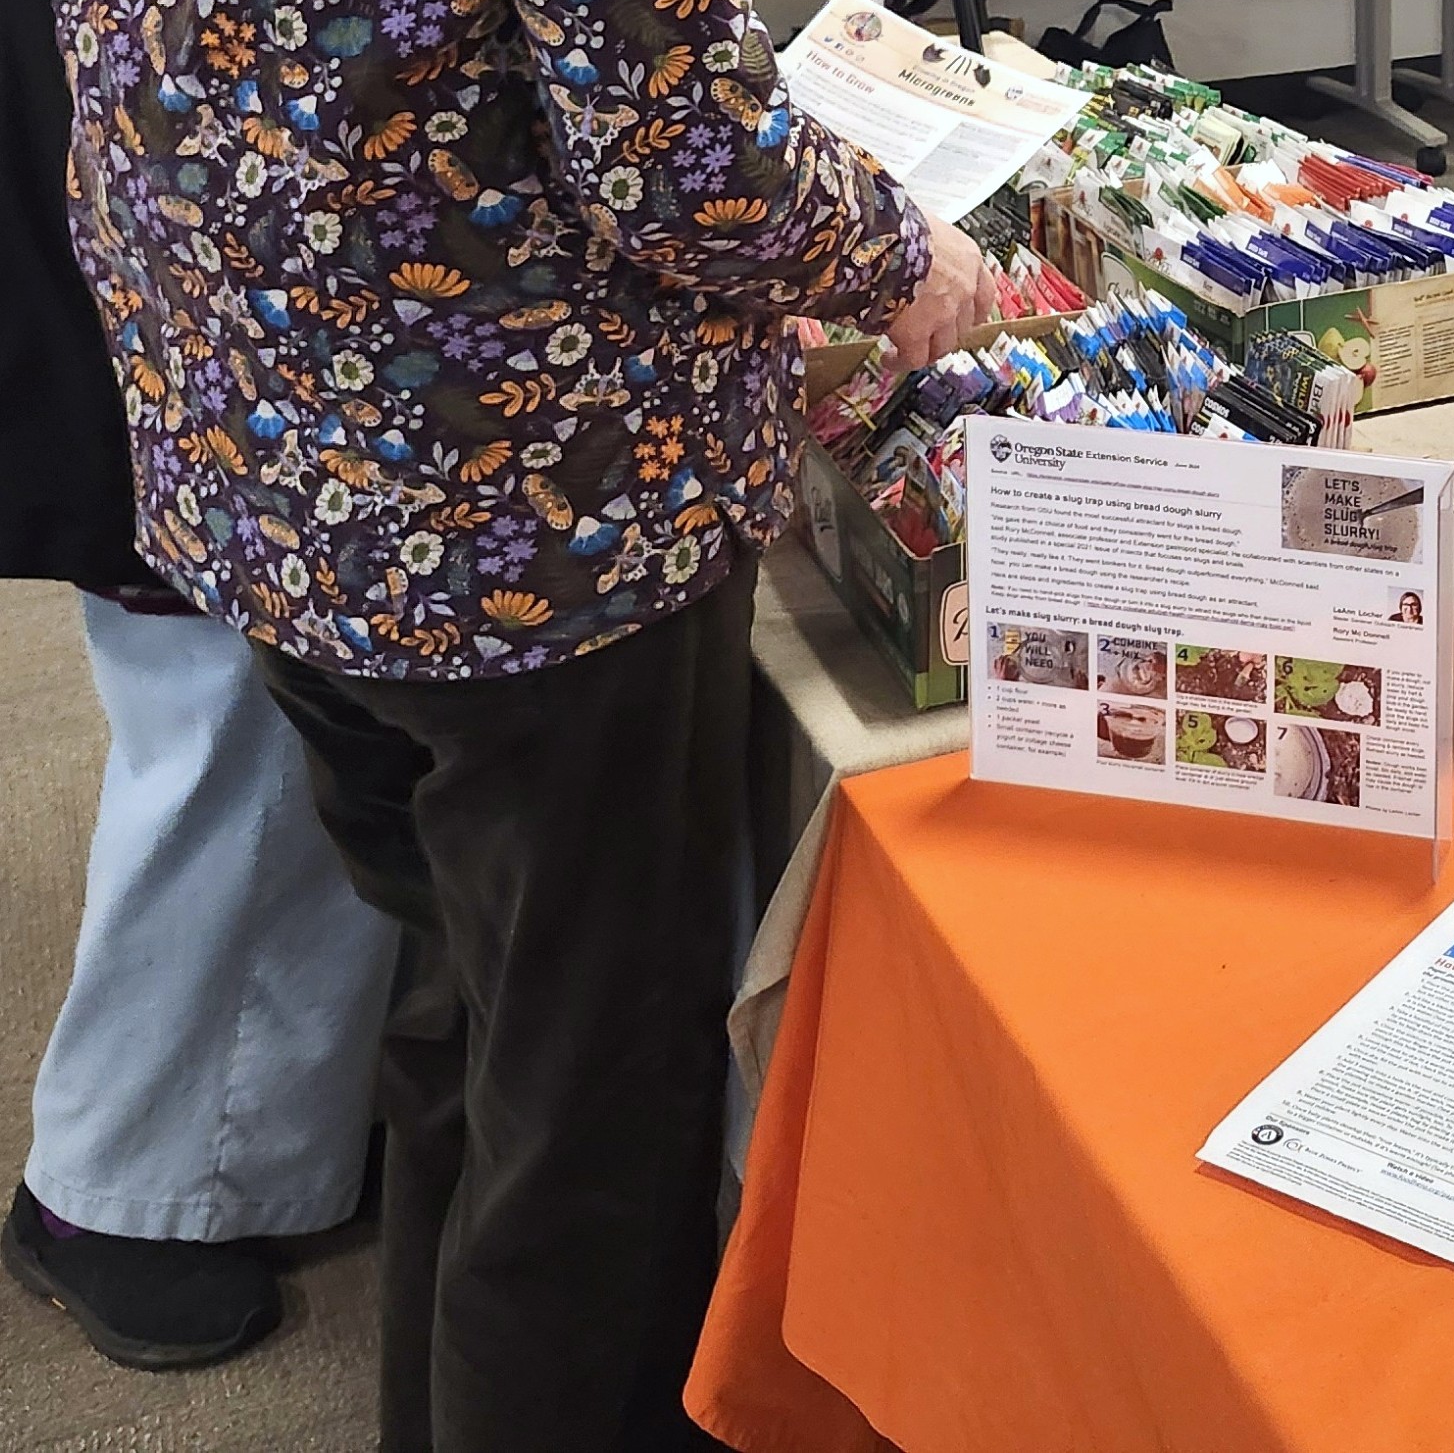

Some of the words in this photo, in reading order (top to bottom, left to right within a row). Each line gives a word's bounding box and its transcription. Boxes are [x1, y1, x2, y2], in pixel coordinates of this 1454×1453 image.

[898, 69, 976, 107] Microgreens
[1205, 397, 1230, 418] COSMOS
[1015, 443, 1054, 456] Oregon
[1056, 444, 1083, 459] State
[1085, 451, 1132, 463] Extension
[1134, 455, 1169, 467] Service
[1015, 454, 1066, 471] University
[991, 487, 1010, 497] How
[1013, 487, 1022, 497] to
[1024, 491, 1052, 501] create
[1063, 494, 1083, 506] slug
[1085, 496, 1103, 508] trap
[1106, 499, 1131, 511] using
[1134, 501, 1160, 512] bread
[1163, 503, 1192, 516] dough
[1195, 507, 1222, 519] slurry
[1324, 493, 1361, 508] MAKE
[1324, 508, 1358, 523] SLUG
[1324, 523, 1380, 540] SLURRY!
[985, 606, 1006, 616] Let's
[1008, 610, 1031, 618] make
[1033, 611, 1051, 623] slug
[1053, 613, 1081, 625] slurry:
[1089, 617, 1113, 628] bread
[1116, 620, 1142, 632] dough
[1144, 624, 1162, 636] slug
[1164, 626, 1184, 637] trap.
[990, 625, 999, 639] 1
[1025, 632, 1046, 642] YOU
[1025, 646, 1051, 656] WILL
[1100, 639, 1111, 652] 2
[1177, 648, 1189, 661] 4
[1025, 657, 1053, 669] NEED
[1282, 661, 1294, 675] 6
[1100, 704, 1111, 716] 3
[1187, 716, 1198, 729] 5
[1277, 727, 1288, 740] 7
